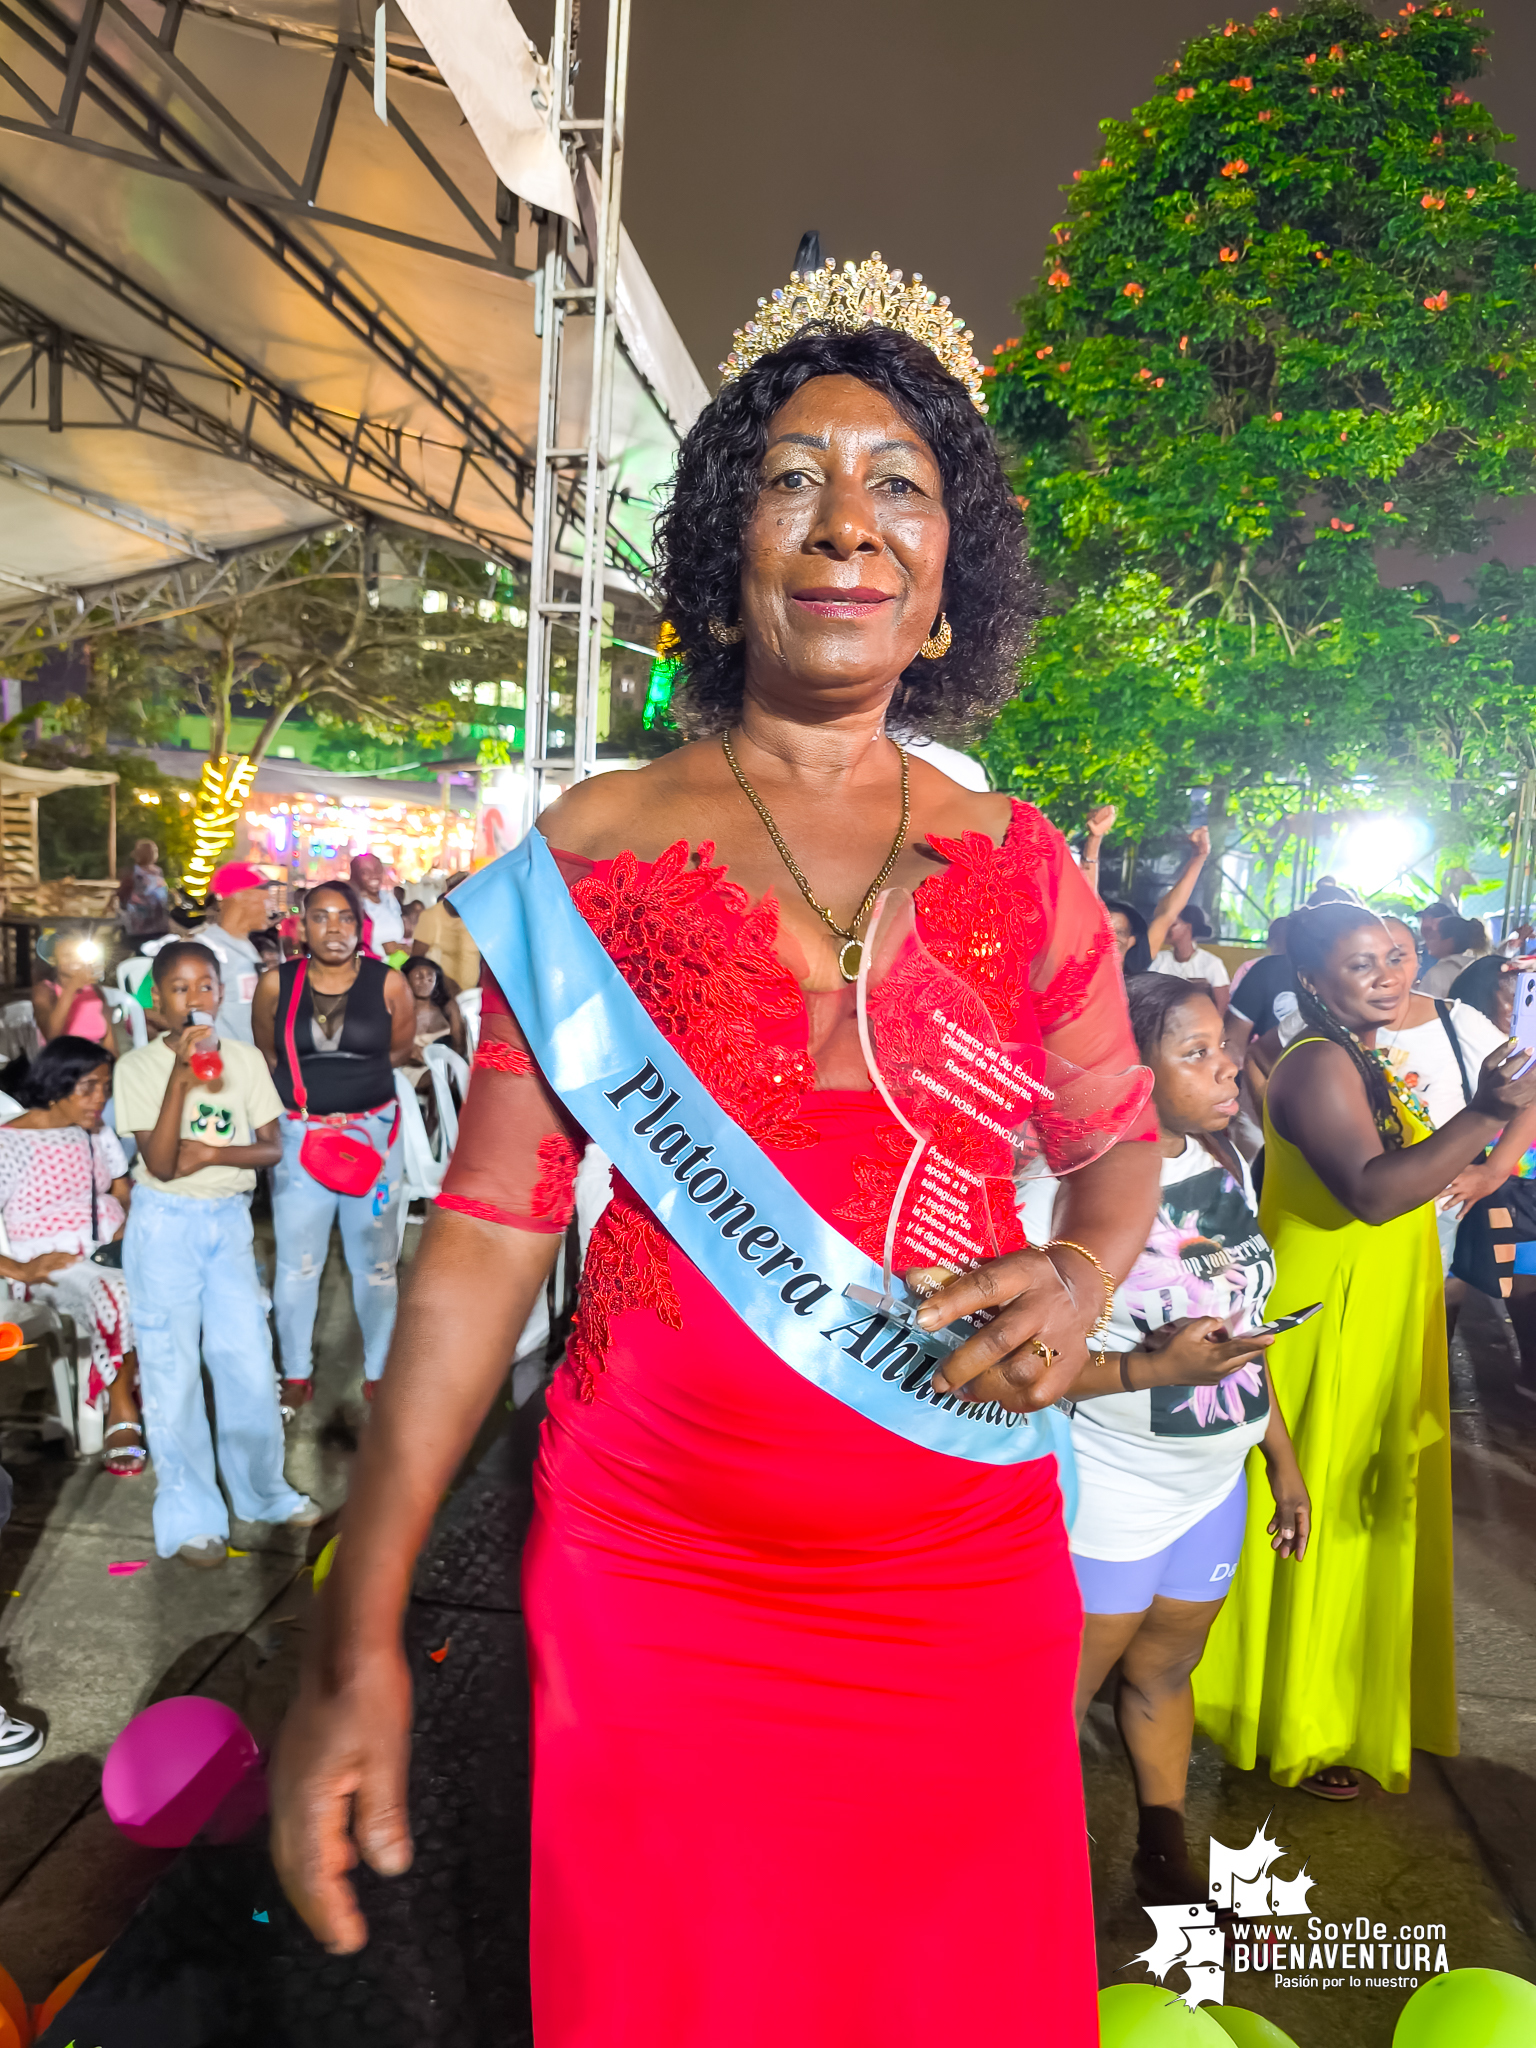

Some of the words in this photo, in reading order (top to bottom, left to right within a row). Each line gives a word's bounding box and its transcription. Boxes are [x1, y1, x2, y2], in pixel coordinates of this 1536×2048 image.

[932, 1009, 947, 1026] En
[945, 1021, 956, 1033] el
[955, 1027, 984, 1051] marco
[983, 1046, 1000, 1062] del
[998, 1055, 1013, 1072] 5to
[1013, 1065, 1055, 1101] Encuentro
[942, 1032, 976, 1065] Distrital
[975, 1056, 988, 1070] de
[988, 1066, 1033, 1103] Platoneras.
[911, 1069, 953, 1101] CARMEN
[951, 1095, 977, 1119] ROSA
[975, 1112, 1026, 1151] ADVINCULA
[1004, 1102, 1016, 1113] a:
[603, 1055, 834, 1317] Platonera
[924, 1163, 951, 1184] aporte
[952, 1180, 959, 1189] a
[960, 1183, 968, 1194] la
[927, 1146, 944, 1162] Por
[944, 1158, 955, 1170] su
[955, 1165, 982, 1187] valioso
[918, 1194, 926, 1203] y
[960, 1219, 972, 1231] de
[921, 1178, 970, 1213] salvaguarda
[904, 1236, 937, 1261] mujeres
[906, 1221, 915, 1231] y
[914, 1223, 923, 1236] la
[923, 1231, 959, 1257] dignidad
[958, 1252, 969, 1264] de
[911, 1204, 921, 1217] la
[920, 1212, 946, 1232] pesca
[946, 1228, 984, 1255] artesanal
